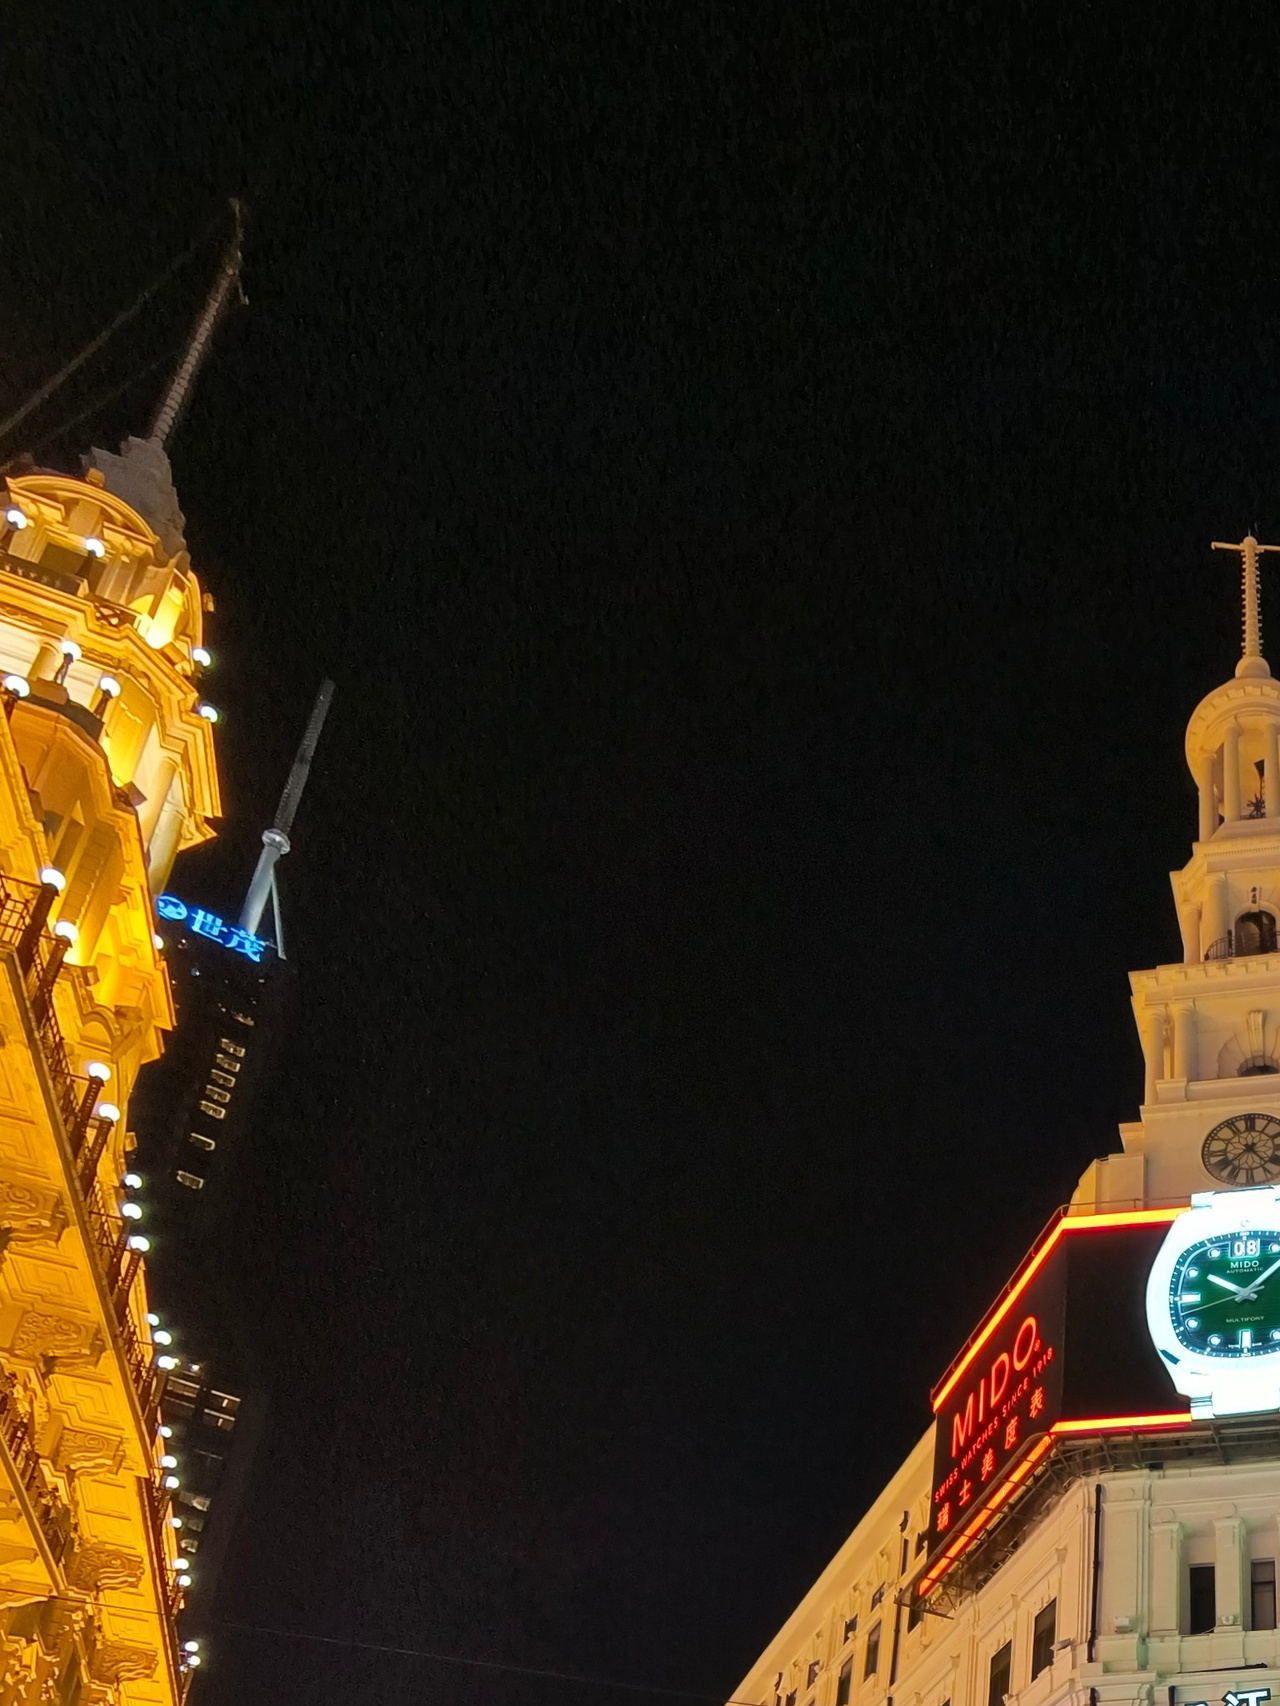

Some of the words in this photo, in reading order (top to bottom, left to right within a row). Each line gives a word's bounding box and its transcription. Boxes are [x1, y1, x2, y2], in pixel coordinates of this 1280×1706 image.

[191, 908, 266, 963] 世茂
[1230, 1260, 1260, 1269] MIDO
[1233, 1239, 1257, 1257] 08
[935, 1467, 959, 1503] SWISS
[960, 1416, 999, 1470] WATCHES
[1002, 1376, 1029, 1418] SINCE
[1033, 1347, 1054, 1378] 1918
[952, 1316, 1037, 1457] MIDO
[937, 1386, 1043, 1532] 瑞士美度表
